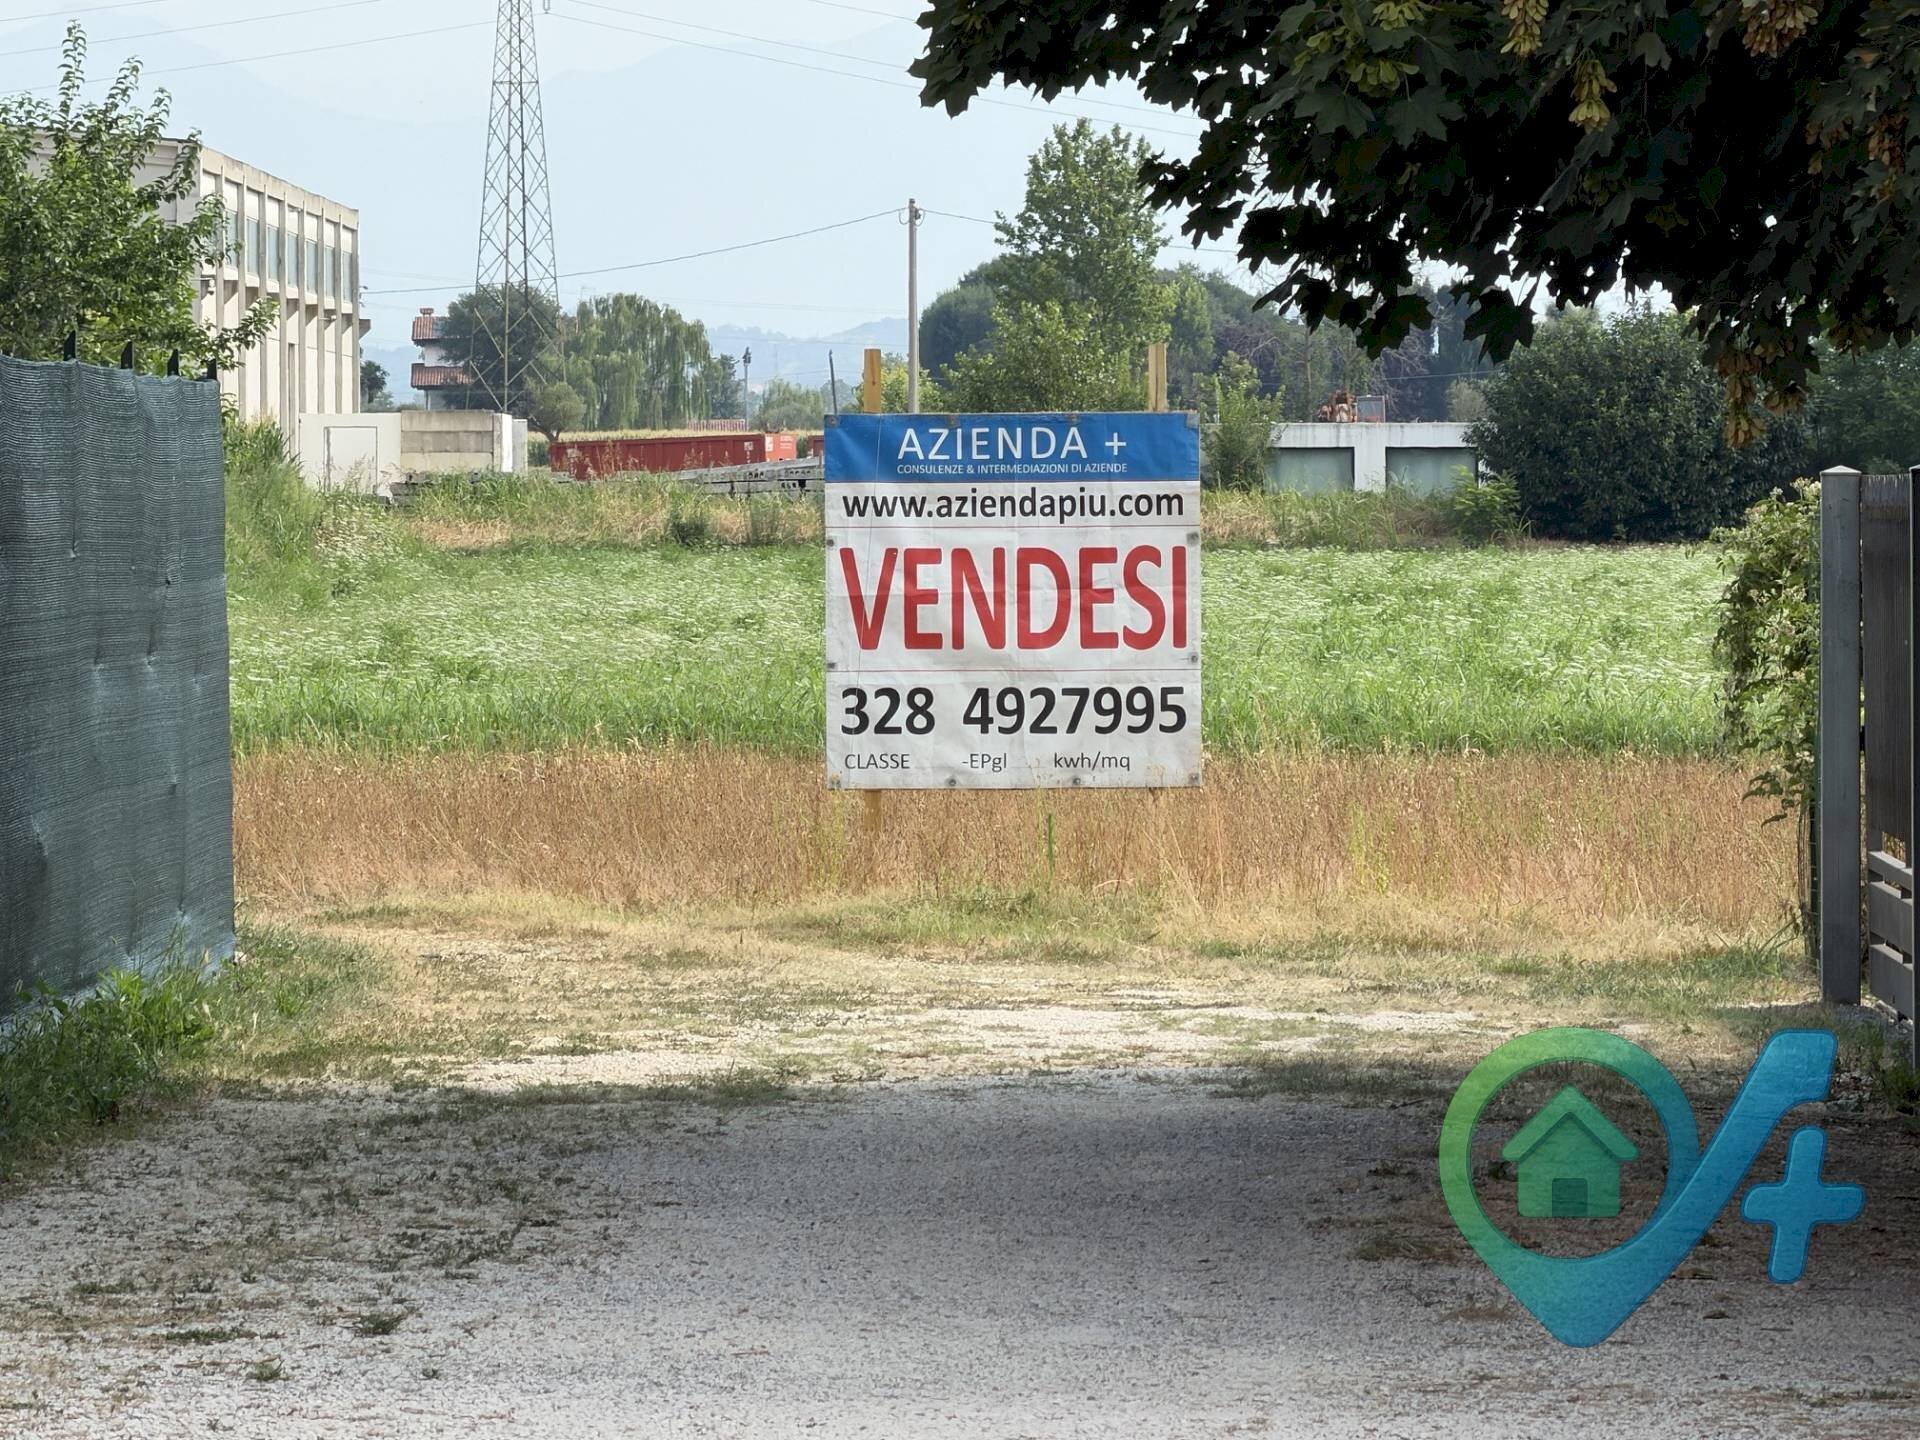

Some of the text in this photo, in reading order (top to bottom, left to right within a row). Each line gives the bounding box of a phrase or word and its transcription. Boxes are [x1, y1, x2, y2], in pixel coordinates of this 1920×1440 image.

[898, 427, 1088, 460] AZIENDA
[897, 463, 1128, 475] CONSULENZE & INTERMEDIAZIONI DI AZIENDE
[842, 486, 1184, 524] www.aziendapiu.com
[839, 544, 1188, 651] VENDESI
[841, 686, 1187, 735] 328 4927995
[844, 753, 910, 770] CLASSE
[1054, 752, 1130, 772] kwh/mq
